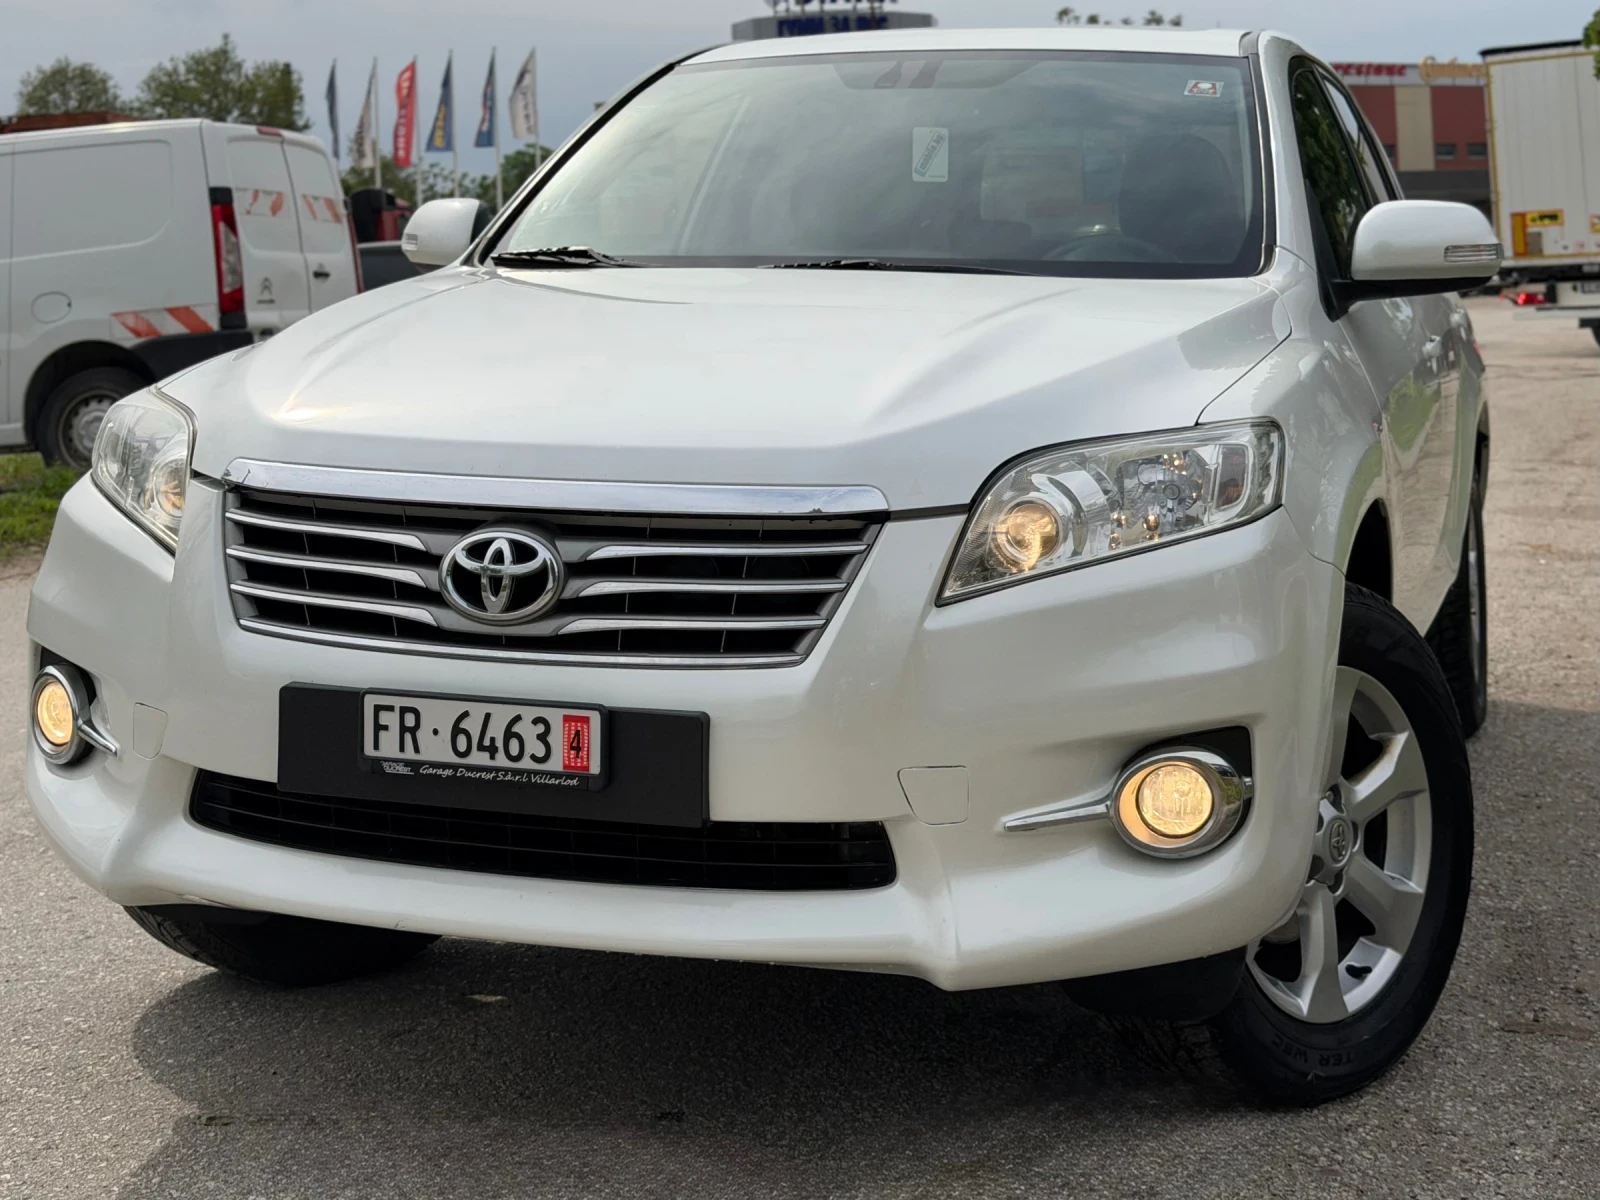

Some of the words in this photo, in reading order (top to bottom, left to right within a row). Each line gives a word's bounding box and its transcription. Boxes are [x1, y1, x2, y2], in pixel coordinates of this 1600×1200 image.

[569, 729, 582, 758] 4
[419, 764, 454, 777] Garage
[456, 768, 497, 780] Ducrest
[530, 773, 579, 786] Villarlod
